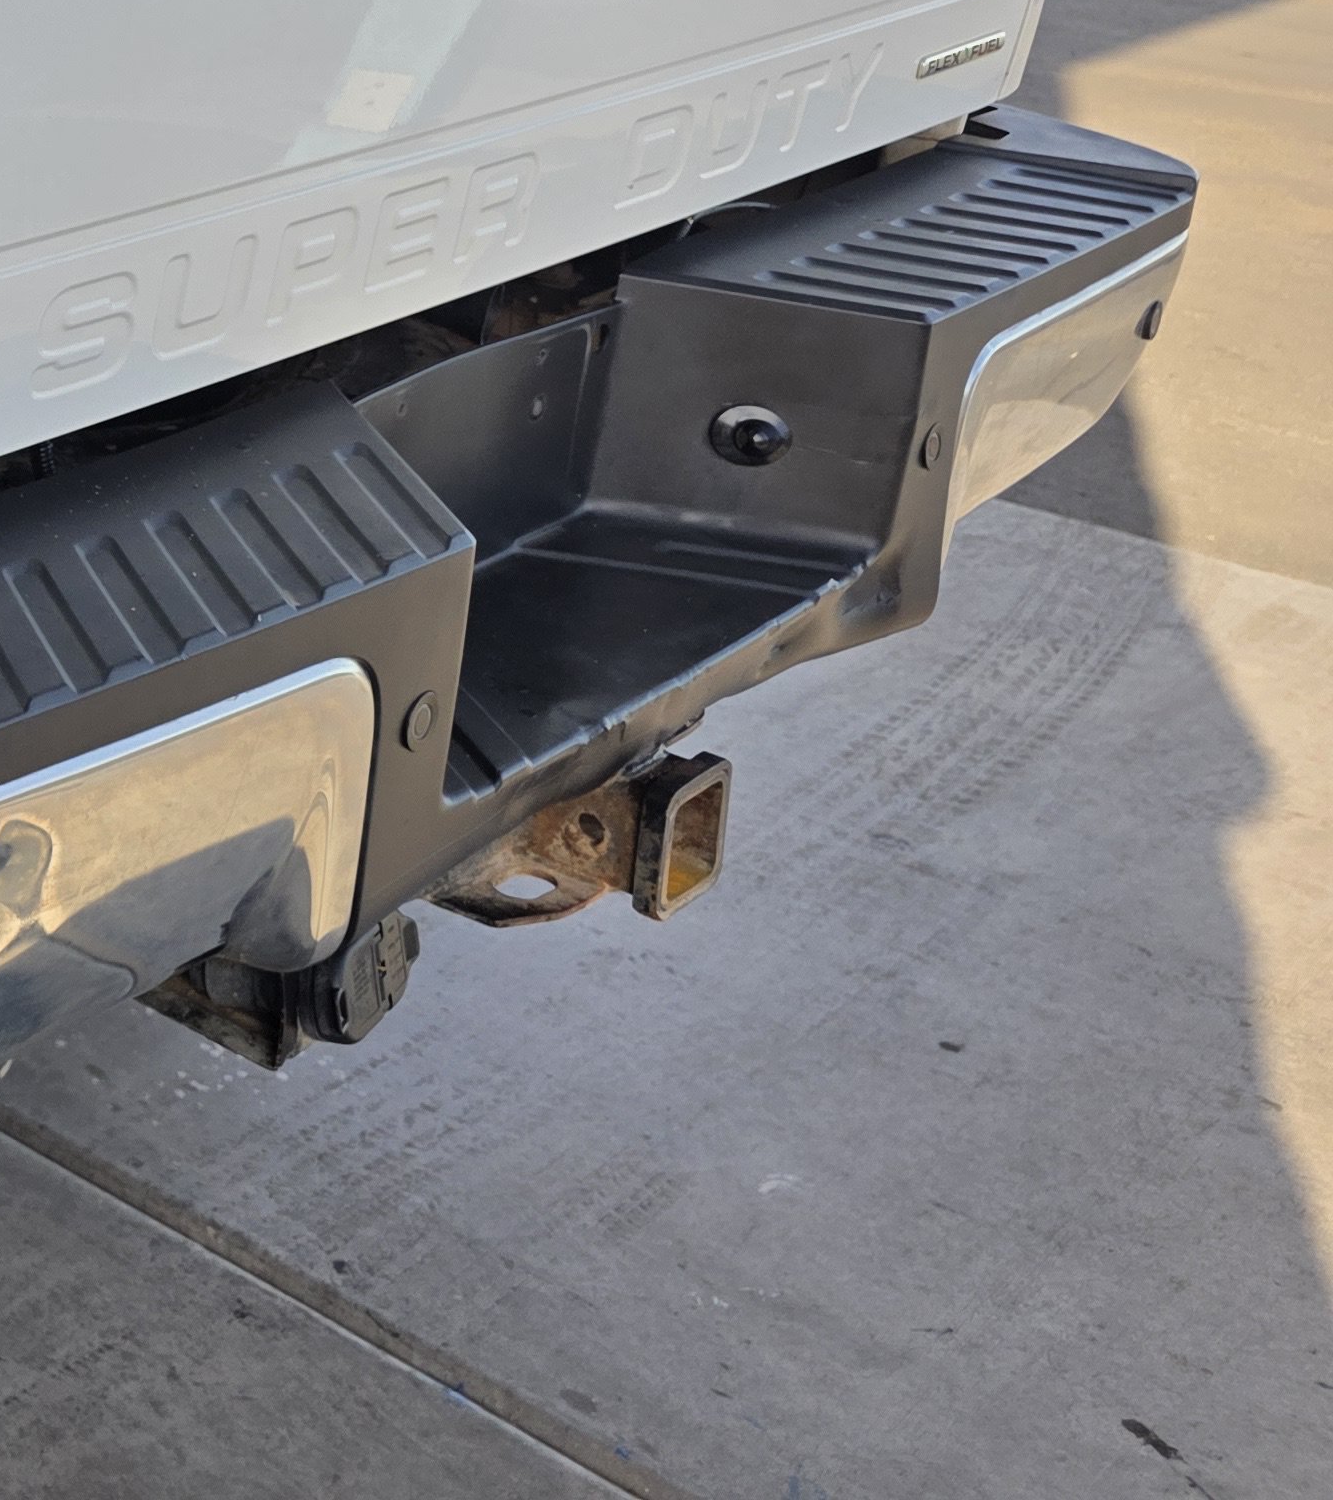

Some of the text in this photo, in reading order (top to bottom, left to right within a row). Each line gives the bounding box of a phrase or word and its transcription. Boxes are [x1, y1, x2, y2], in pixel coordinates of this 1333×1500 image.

[925, 36, 1005, 76] FLEX FUEL
[29, 41, 885, 403] SUPER DUTY
